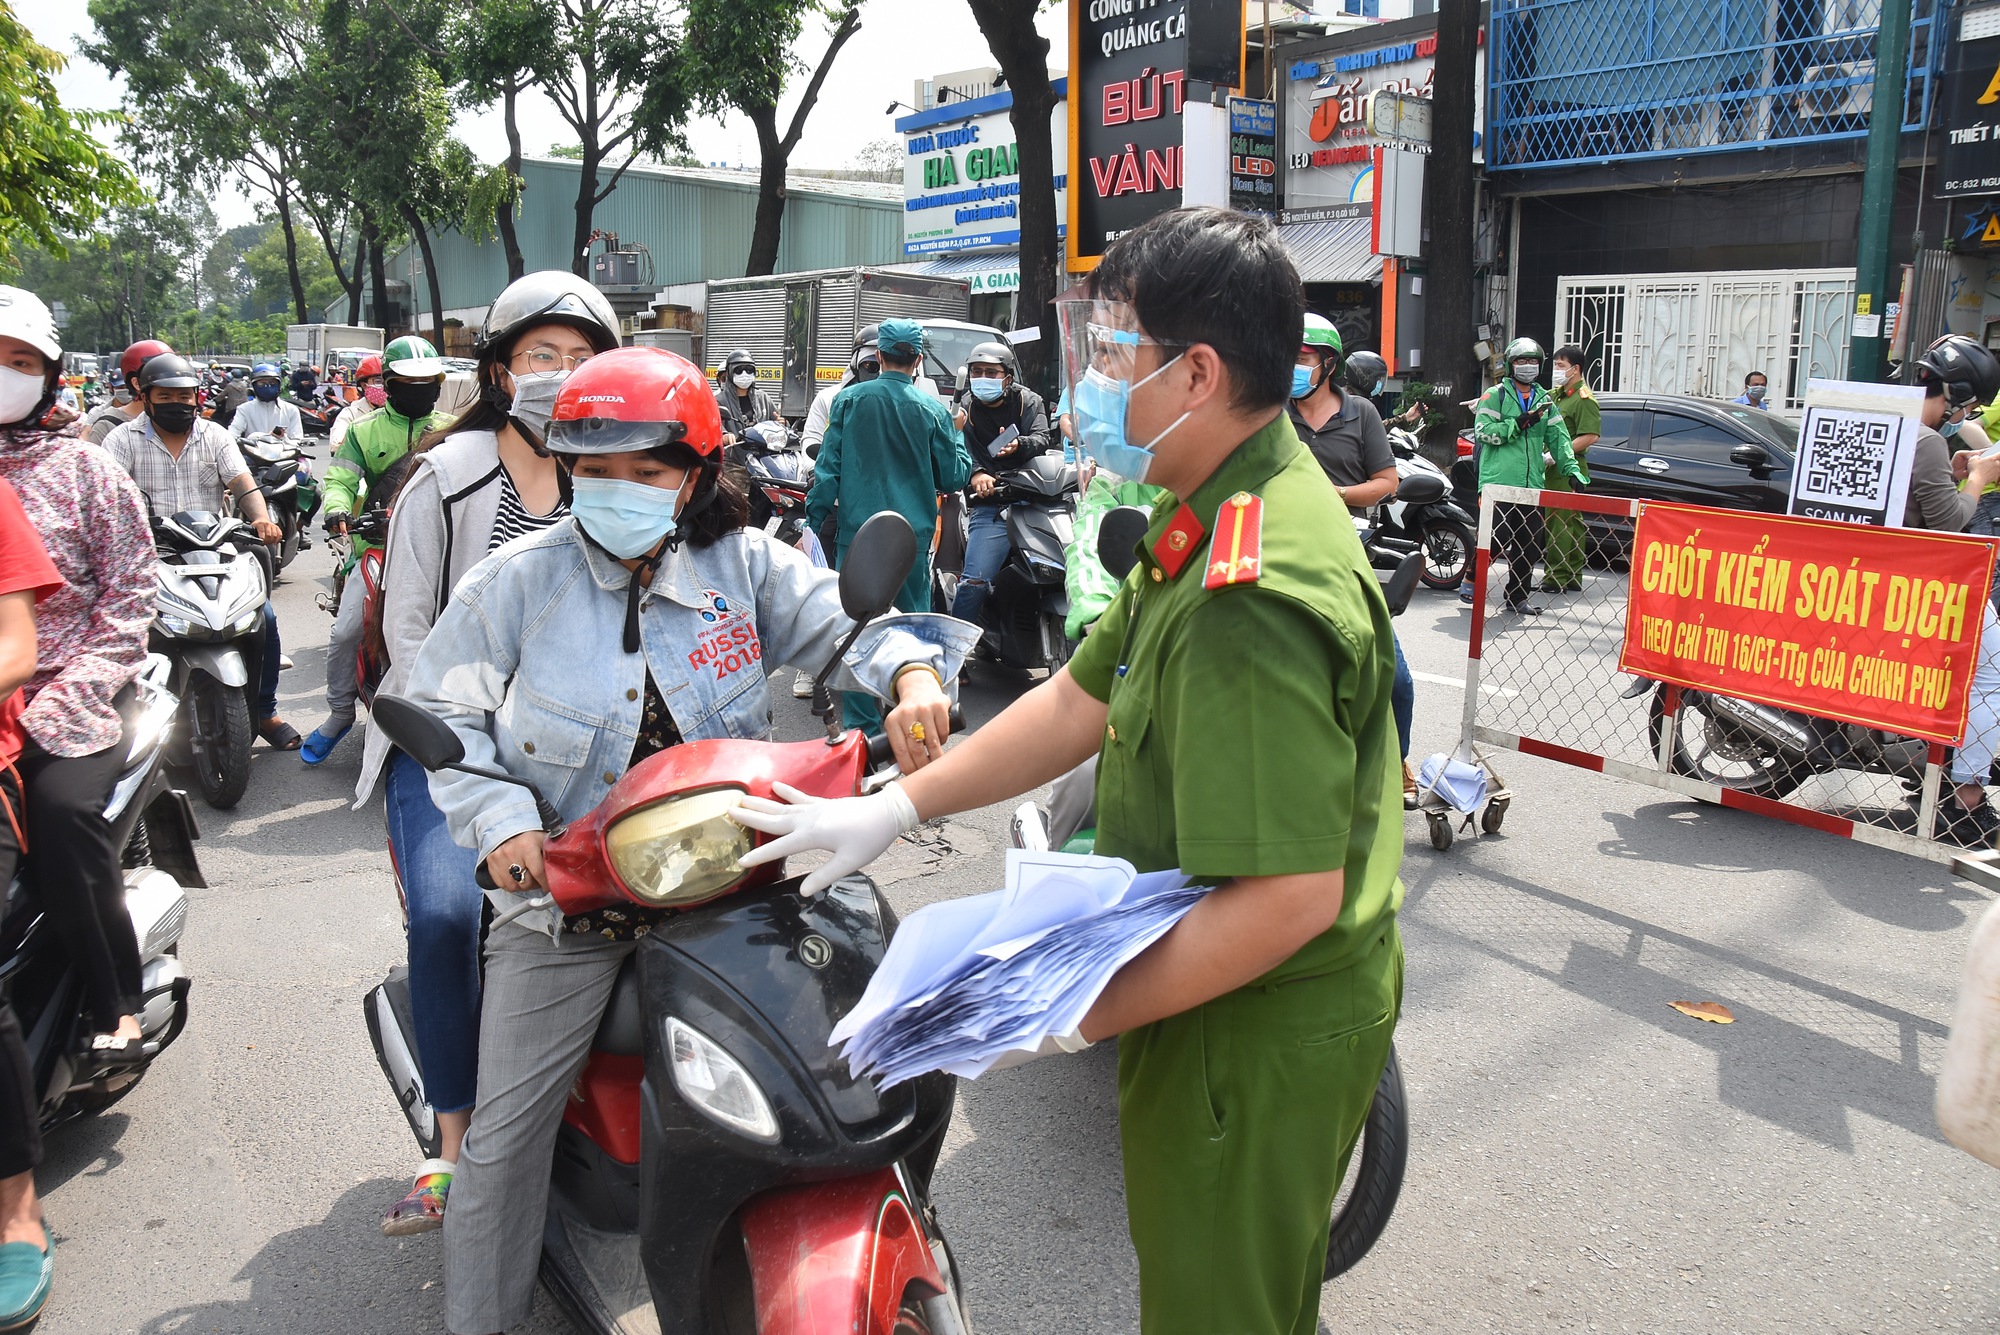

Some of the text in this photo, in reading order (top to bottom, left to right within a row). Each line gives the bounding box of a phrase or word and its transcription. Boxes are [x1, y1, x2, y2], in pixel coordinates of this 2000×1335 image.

[1101, 17, 1161, 58] QUẢNG
[1334, 52, 1362, 73] TNHH
[1102, 66, 1184, 126] BÚT
[1231, 100, 1275, 118] Quảng Cáo
[908, 120, 980, 155] NHÀ THUỐC
[1950, 121, 1990, 145] THIẾT
[923, 149, 959, 189] HÀ
[1089, 143, 1184, 198] VÀN
[1232, 155, 1276, 177] LED
[1289, 152, 1309, 170] LED
[1232, 176, 1274, 195] Neon Sign
[578, 395, 626, 403] HONDA
[1804, 507, 1873, 525] SCAN ME
[1641, 528, 1970, 648] CHỐT KIỂM SOÁT DỊCH
[712, 641, 762, 681] 2018
[1641, 613, 1953, 711] THEO CHỈ THỊ 16/CT-TTg CỦA CHÍNH PHỦ
